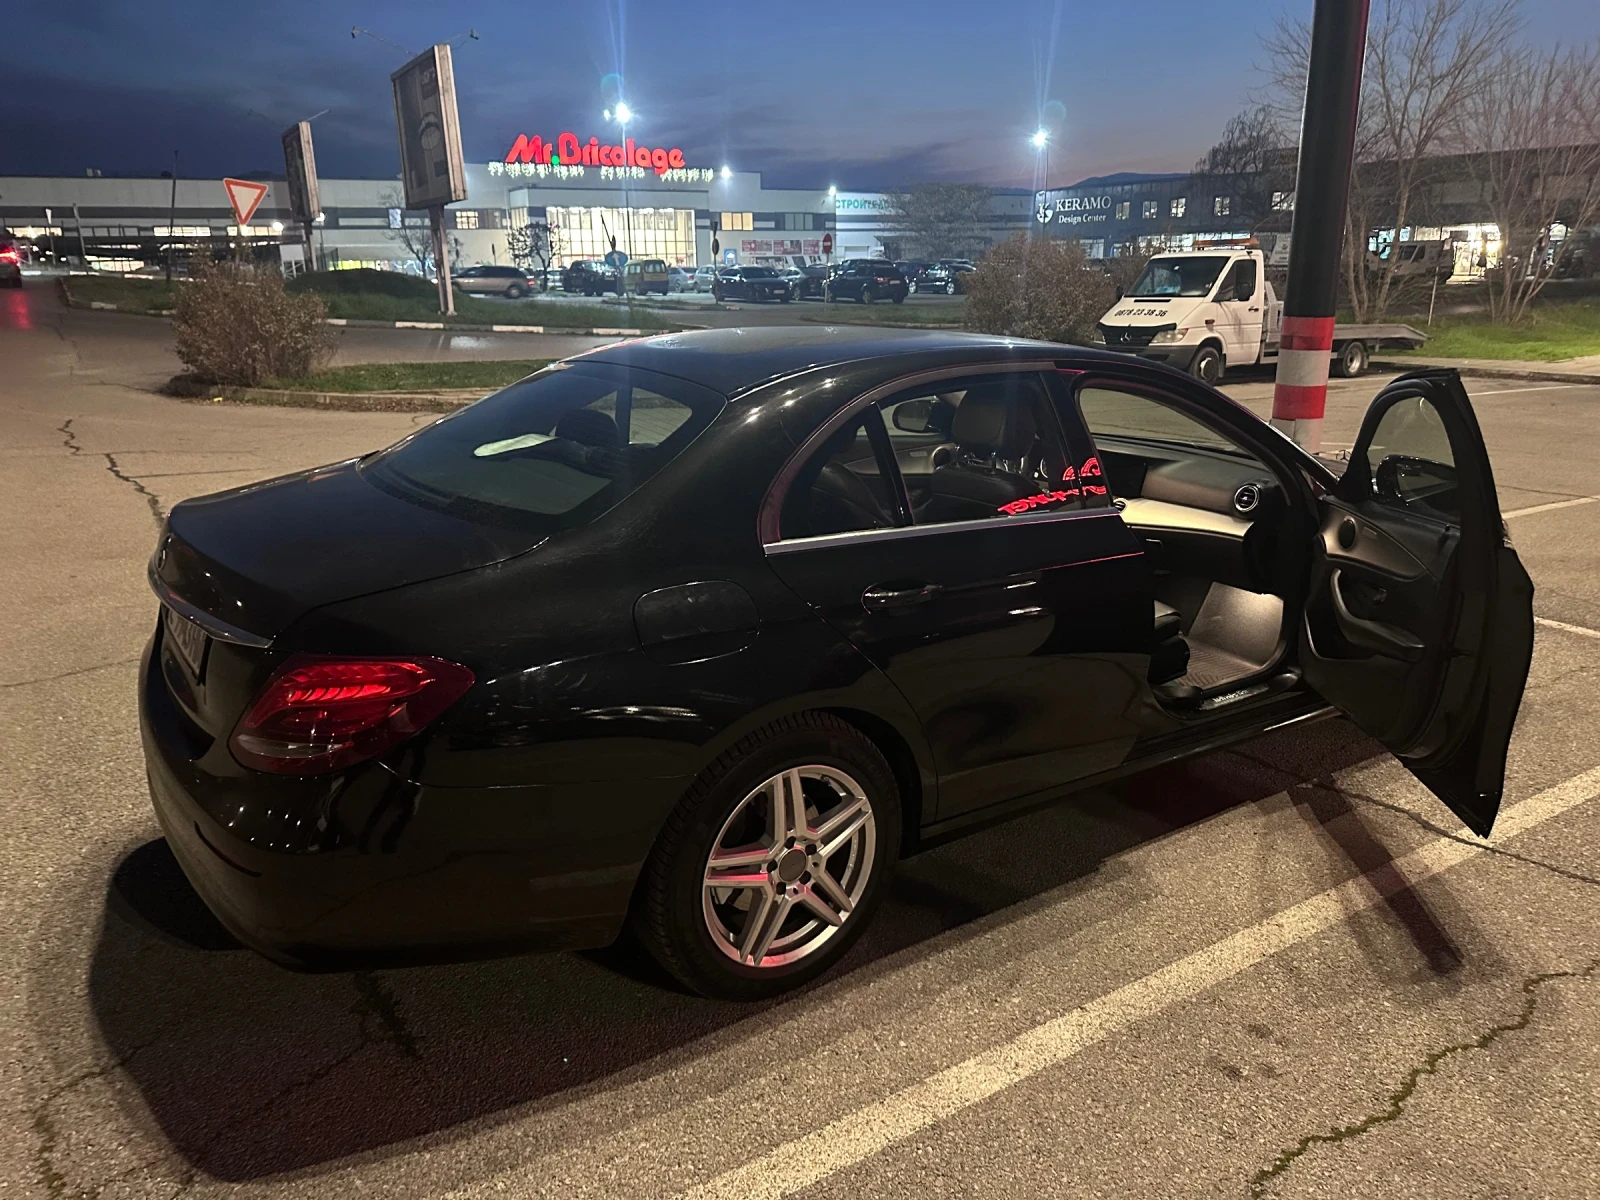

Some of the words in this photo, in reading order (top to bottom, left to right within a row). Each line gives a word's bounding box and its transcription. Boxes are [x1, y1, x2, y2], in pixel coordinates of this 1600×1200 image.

[1055, 195, 1112, 212] KERAMO
[1058, 213, 1082, 226] Design
[1082, 213, 1107, 223] Center
[1132, 308, 1146, 316] 23
[1144, 308, 1157, 316] 38
